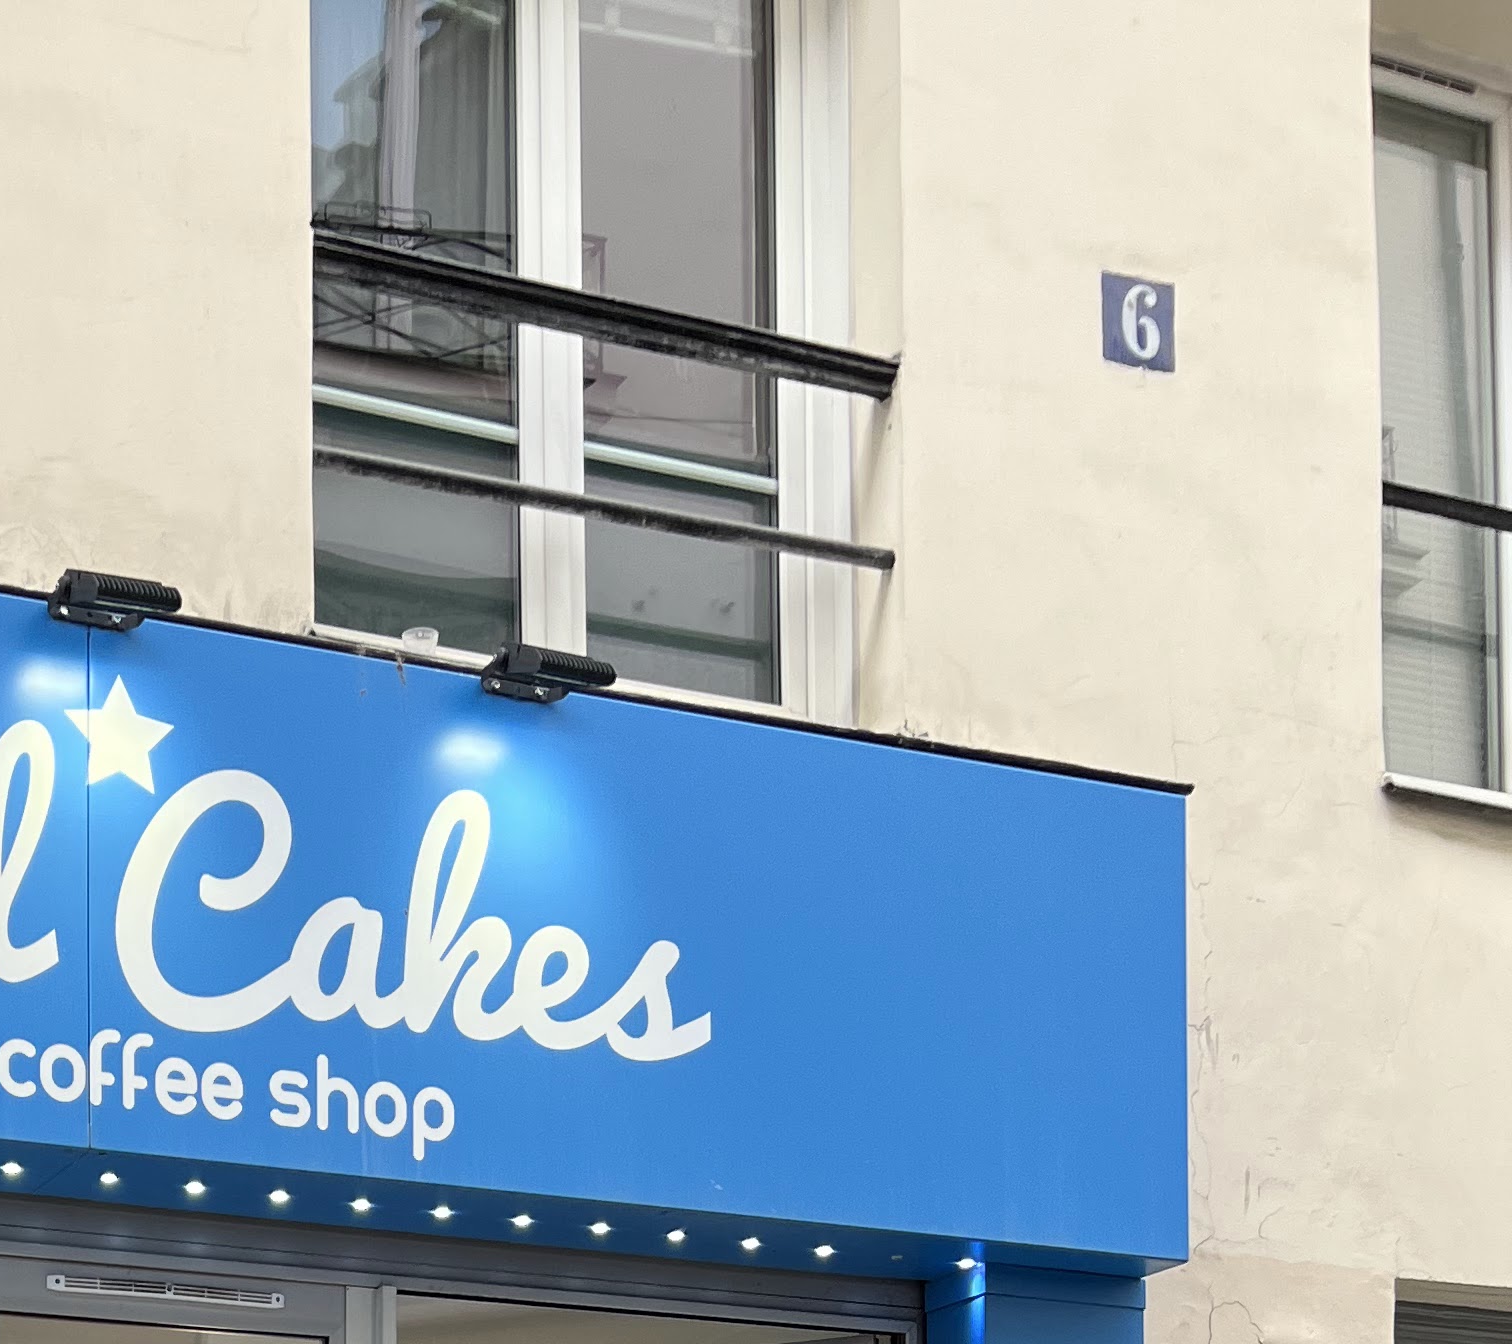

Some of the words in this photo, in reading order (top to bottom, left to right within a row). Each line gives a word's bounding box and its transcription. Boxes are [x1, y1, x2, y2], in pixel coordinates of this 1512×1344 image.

[1122, 284, 1161, 361] 6
[115, 768, 712, 1062] Cakes
[269, 1055, 456, 1159] shop
